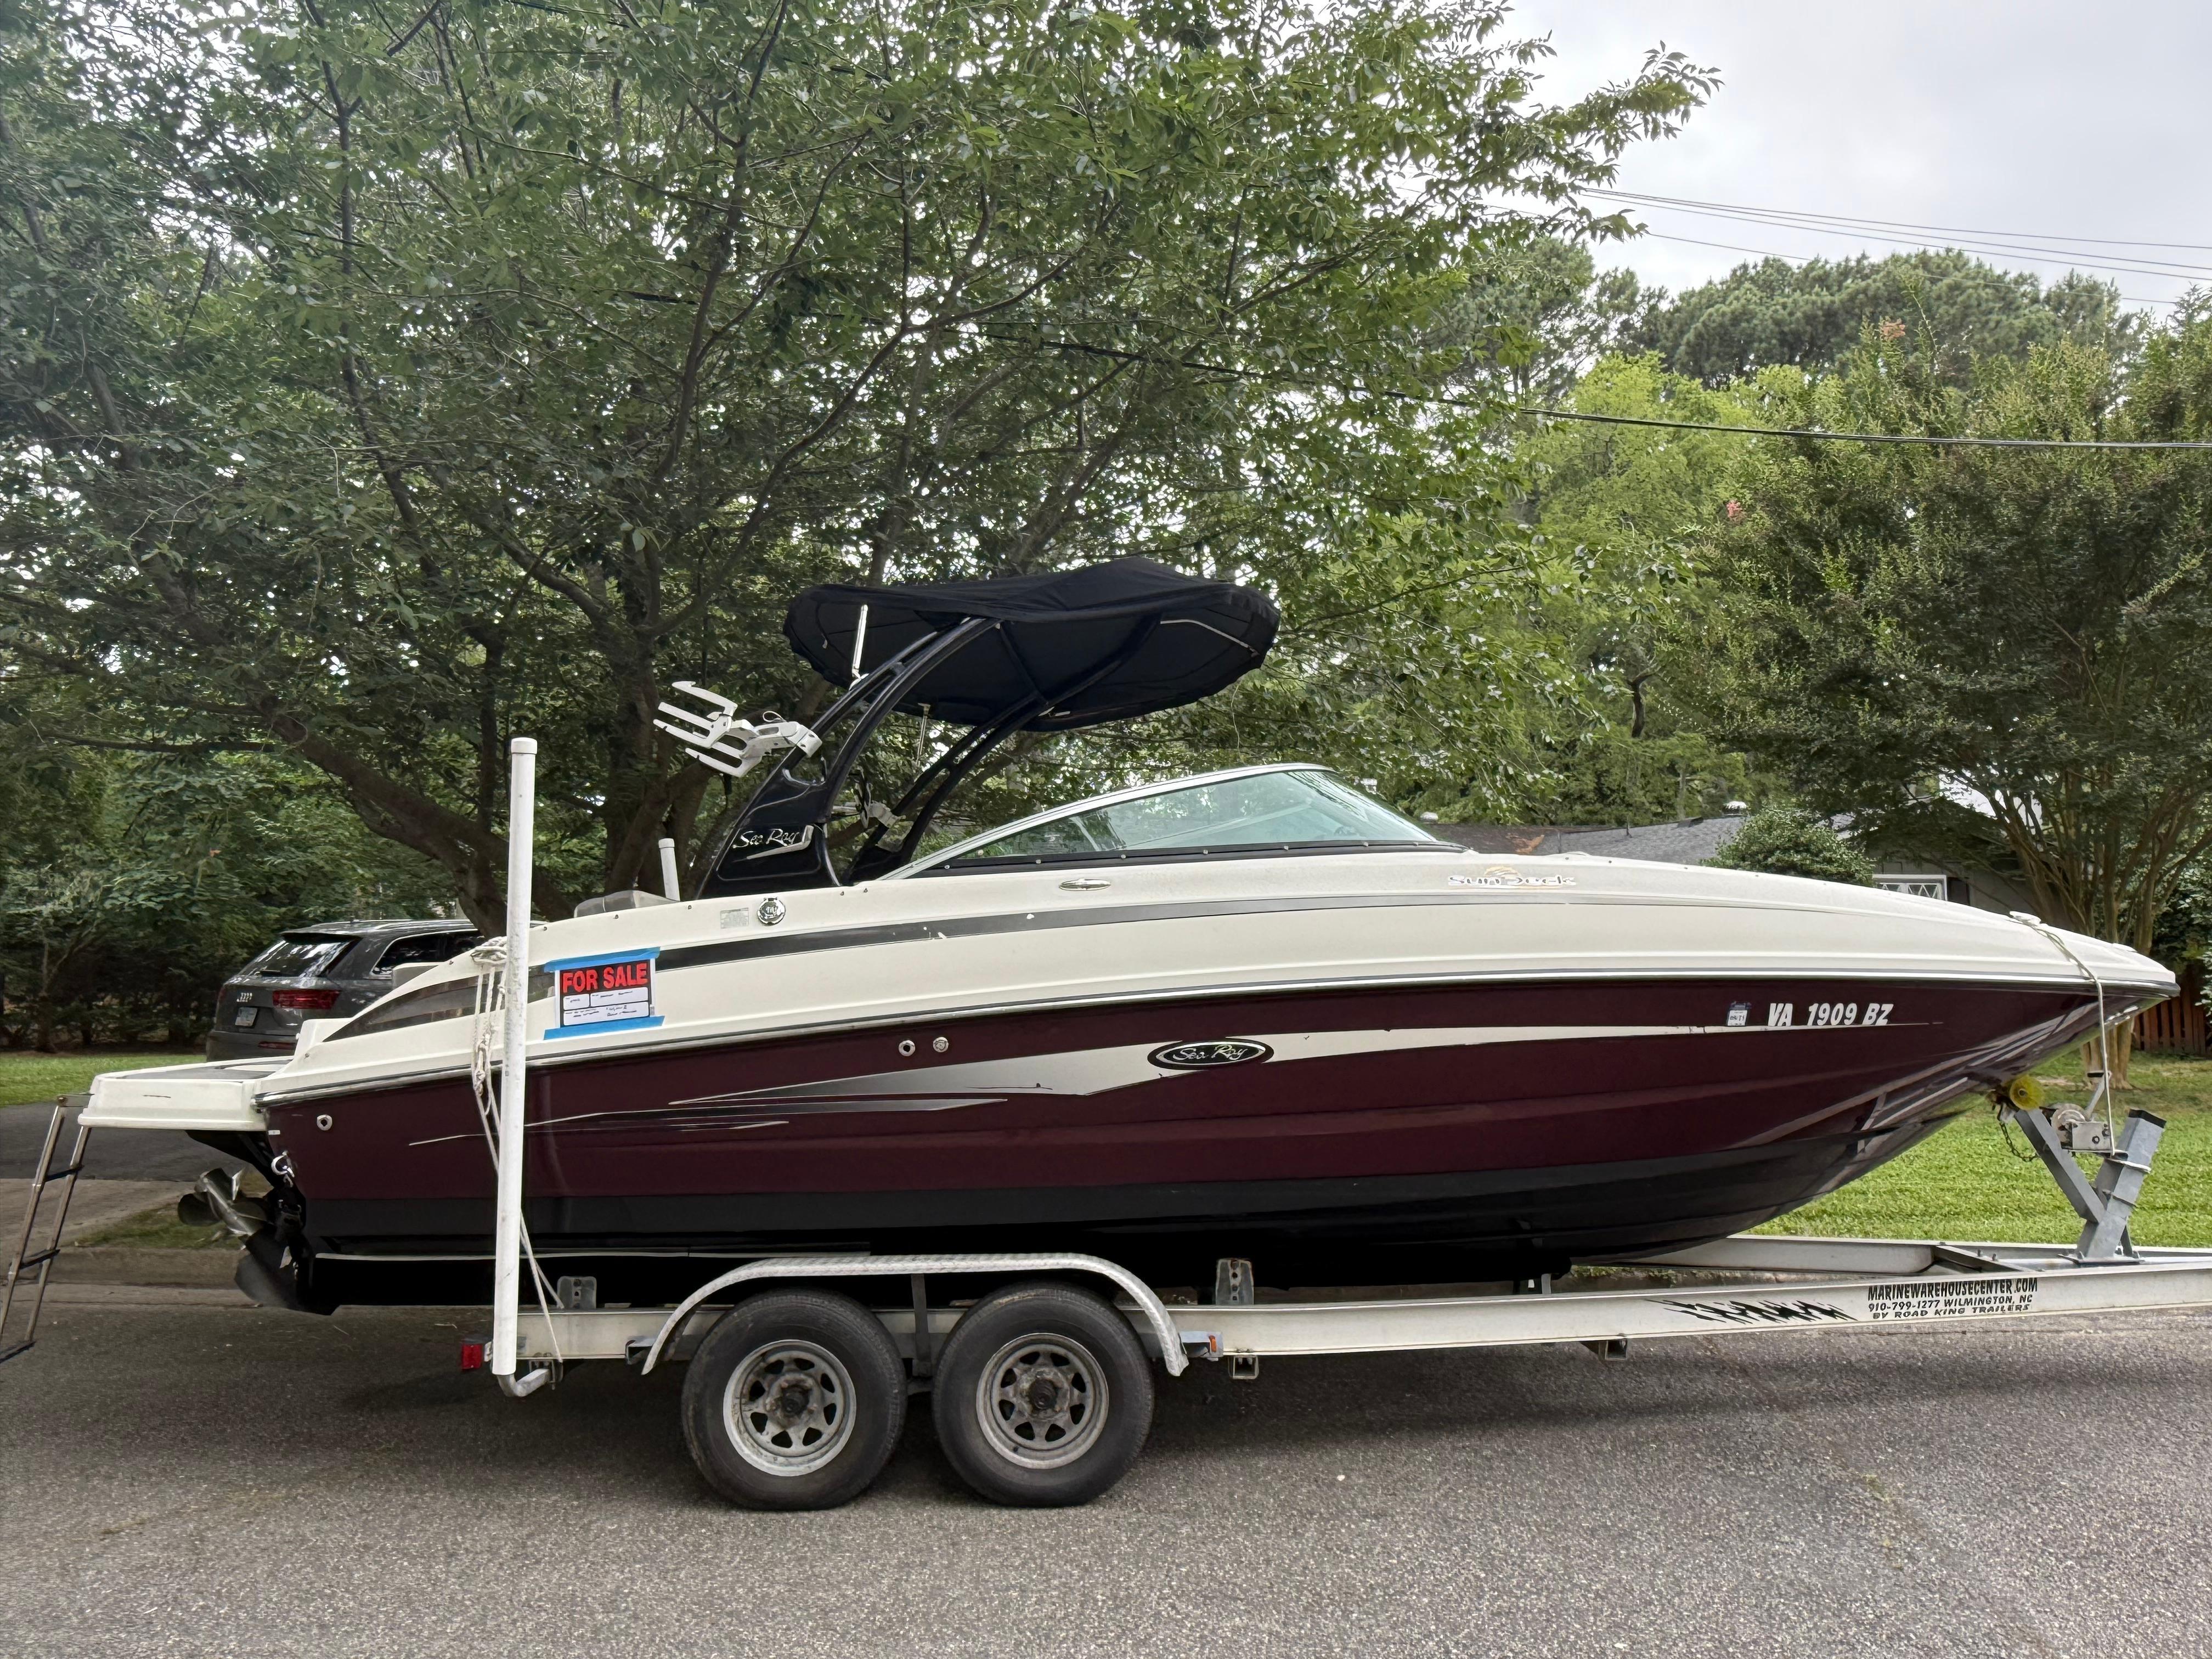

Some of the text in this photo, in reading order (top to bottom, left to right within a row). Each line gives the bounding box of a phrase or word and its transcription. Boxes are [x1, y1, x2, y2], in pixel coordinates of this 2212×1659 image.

[732, 828, 799, 849] Sea Ray
[562, 963, 648, 993] FOR SALE
[1768, 1003, 1793, 1026] VA
[1807, 1003, 1857, 1026] 1909
[1862, 1003, 1894, 1026] BZ
[1172, 1044, 1248, 1060] Sea Ray
[1868, 1299, 1940, 1312] 910-799-1277
[2019, 1294, 2033, 1304] NC
[1894, 1310, 1928, 1318] ROAD
[1934, 1307, 1965, 1316] KING
[1972, 1304, 2030, 1313] TRAILERS
